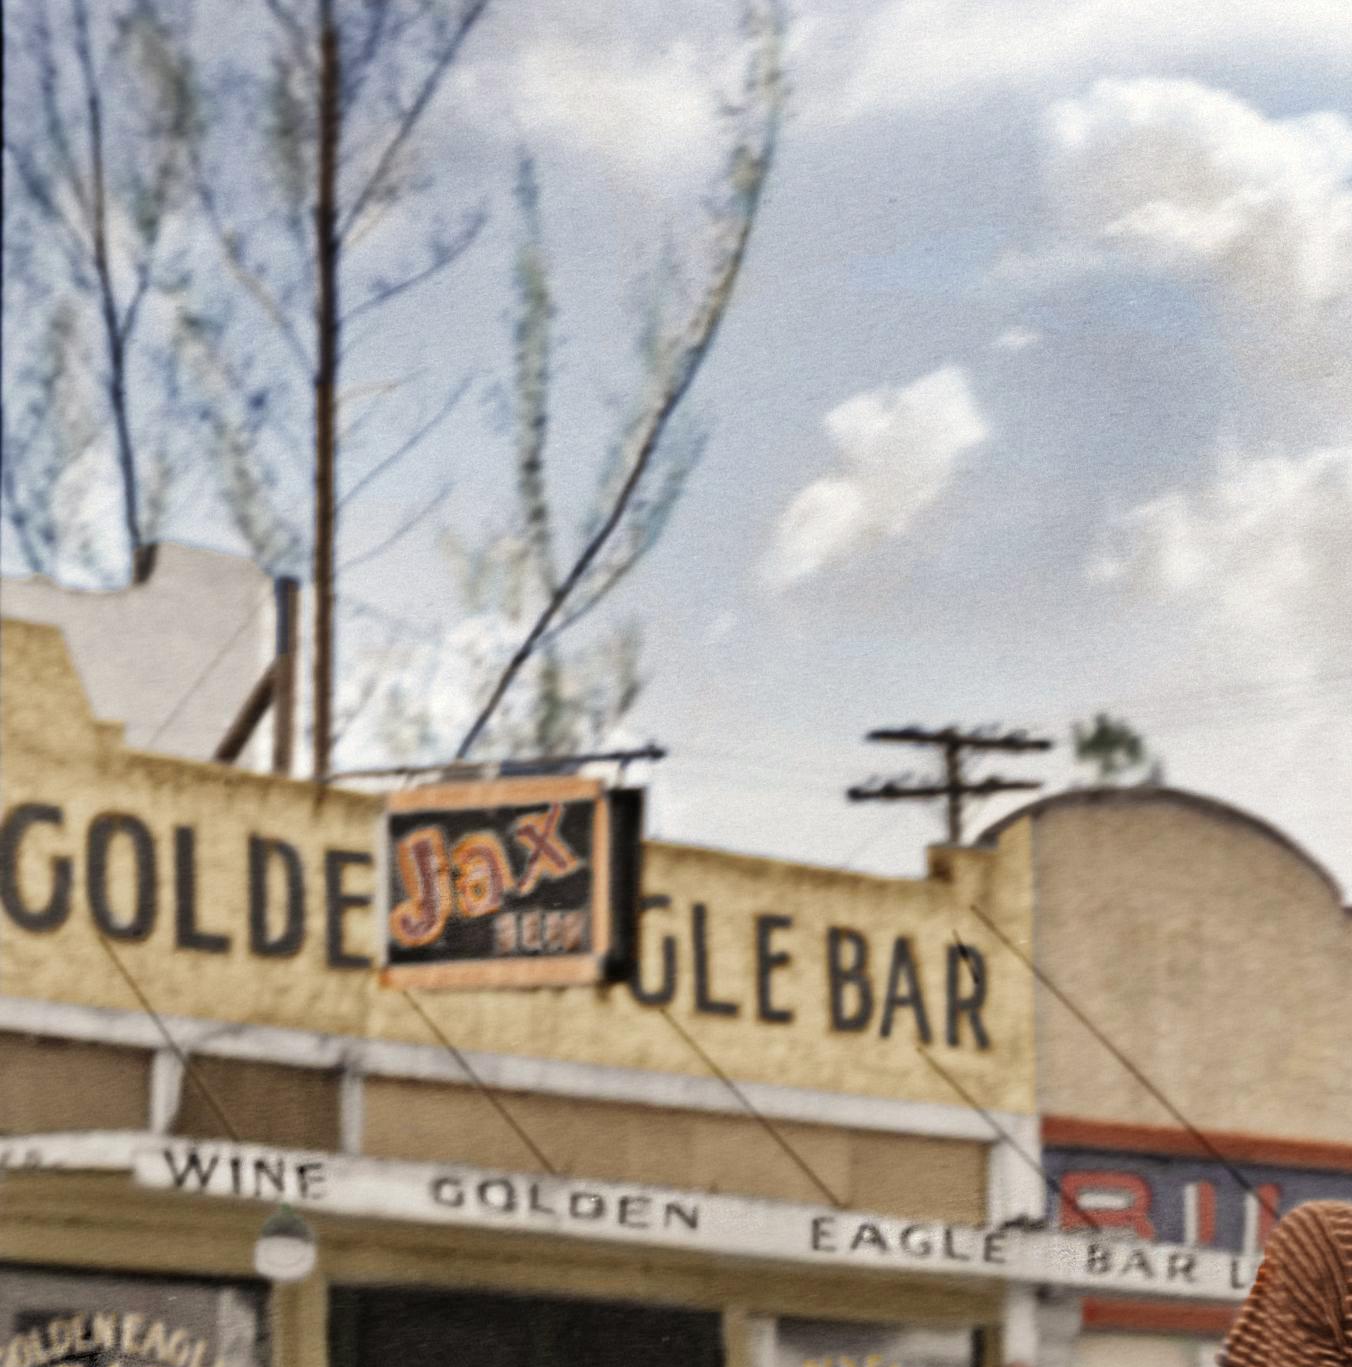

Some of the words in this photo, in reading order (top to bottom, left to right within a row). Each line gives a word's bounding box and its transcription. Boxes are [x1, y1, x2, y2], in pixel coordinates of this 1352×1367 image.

[0, 801, 375, 969] GOLDE
[633, 895, 795, 1024] GLE
[827, 925, 991, 1050] BAR
[390, 801, 580, 947] Jax
[163, 1150, 324, 1200] WINE
[431, 1176, 699, 1229] GOLDEN
[811, 1215, 1007, 1265] EAGLE
[1084, 1243, 1198, 1284] BAR
